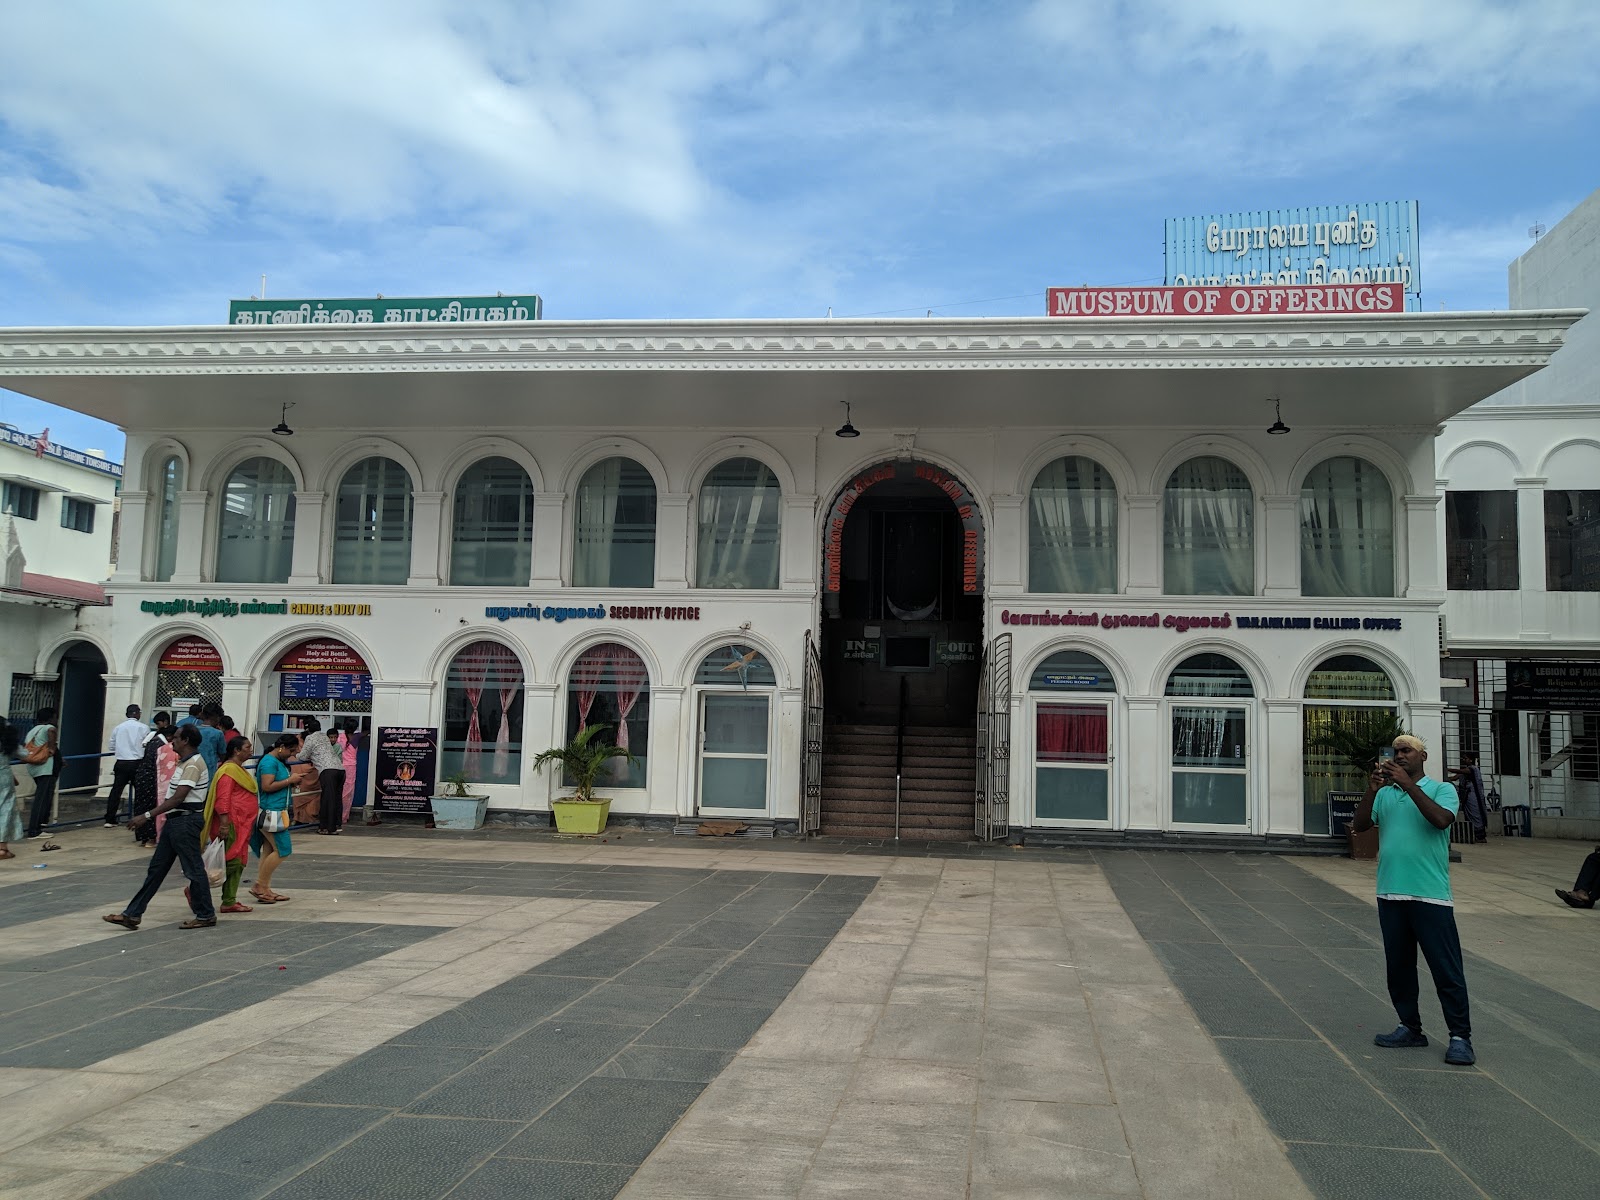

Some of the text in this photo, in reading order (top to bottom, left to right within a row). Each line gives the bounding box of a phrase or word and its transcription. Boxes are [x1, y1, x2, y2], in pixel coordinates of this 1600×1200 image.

[1206, 210, 1377, 260] பேராலய புனித
[1056, 286, 1394, 314] MUSEUM OF OFFERINGS
[235, 299, 529, 325] காணிக்கை காட்சியகம்
[63, 449, 123, 475] SHRINE TONSURE HAL
[914, 465, 977, 592] MUSEUM OF OFFERINGS
[187, 599, 196, 612] &
[290, 603, 371, 616] CANDLE & HOLY OIL
[542, 604, 606, 622] அலுவலகம்
[609, 606, 700, 620] SECURITY OFFICE
[1236, 616, 1402, 631] VAILANKANNI CALLING OFFICE
[845, 640, 866, 650] IN
[948, 642, 975, 652] OUT
[1536, 667, 1566, 676] LEGION
[1569, 668, 1580, 676] OF
[1547, 678, 1577, 687] Religious
